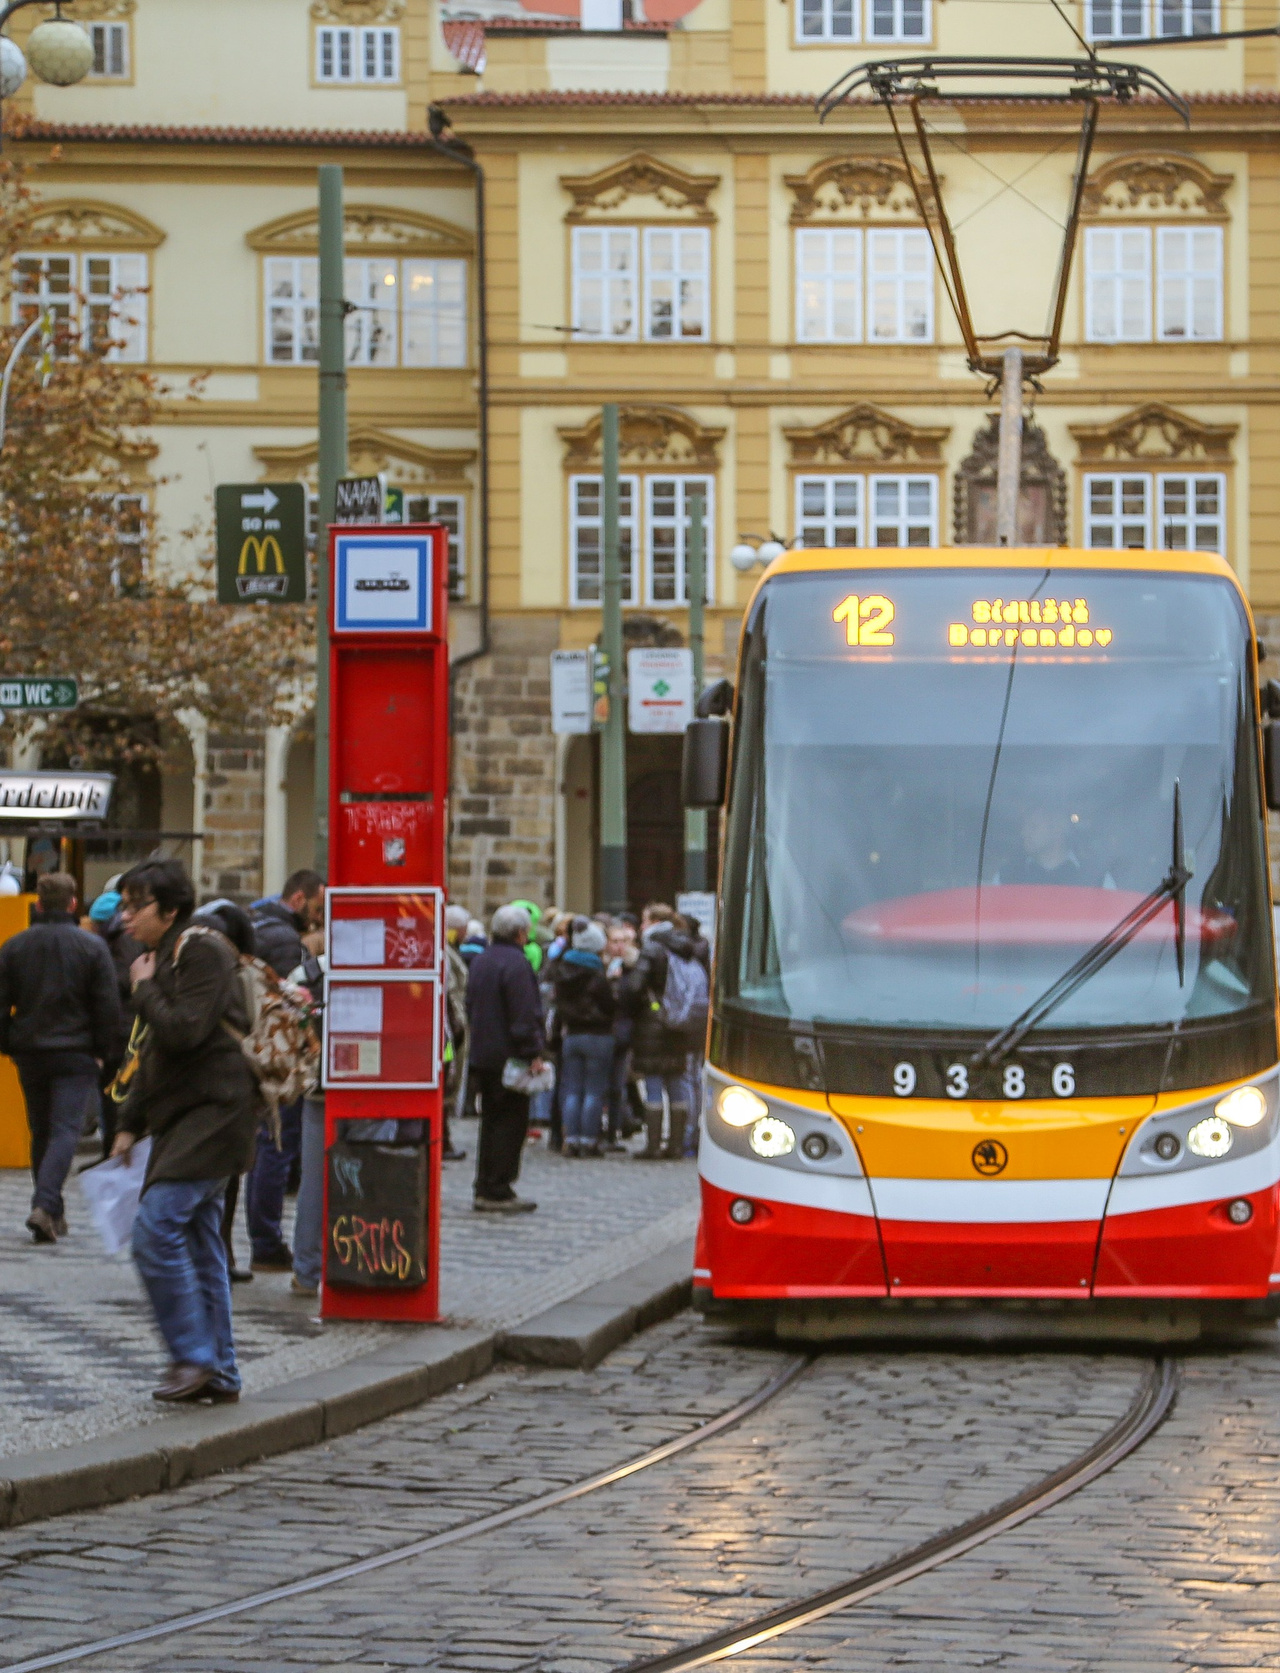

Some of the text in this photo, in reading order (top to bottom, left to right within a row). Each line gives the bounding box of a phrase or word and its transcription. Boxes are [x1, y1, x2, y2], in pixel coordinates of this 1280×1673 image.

[832, 594, 895, 646] 12
[24, 683, 53, 705] WC
[0, 781, 101, 811] rdelník
